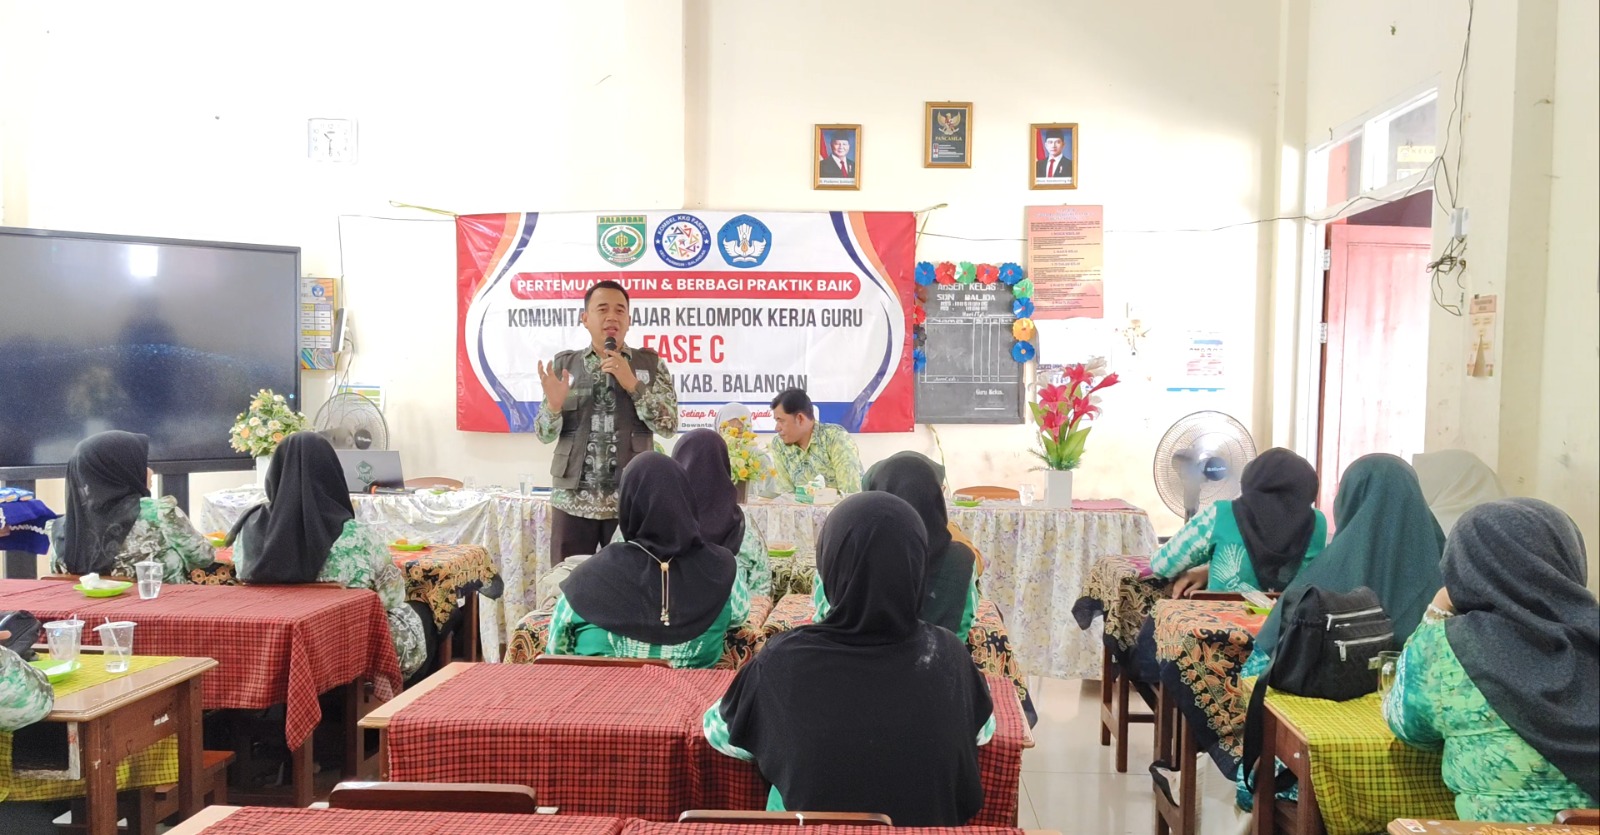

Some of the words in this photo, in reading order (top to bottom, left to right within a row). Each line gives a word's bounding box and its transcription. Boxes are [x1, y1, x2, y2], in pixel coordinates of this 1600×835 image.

[657, 217, 677, 235] KOMBEL
[690, 217, 705, 231] FASE
[517, 279, 606, 292] PERTEMUA
[611, 279, 657, 291] UTIN
[660, 278, 673, 291] &
[676, 278, 744, 291] BERBAGI
[747, 279, 813, 291] PRAKTIK
[817, 279, 853, 291] BAIK
[969, 283, 996, 291] KELAS
[508, 308, 585, 327] KOMUNITA
[630, 307, 671, 327] AJAR
[676, 307, 763, 327] KELOMPOK
[768, 308, 817, 327] KERJA
[821, 308, 863, 327] GURU
[709, 335, 724, 363] C
[680, 374, 717, 393] KAB.
[723, 374, 807, 393] BALANGAN
[680, 409, 706, 419] Setiap
[751, 409, 772, 419] njadi
